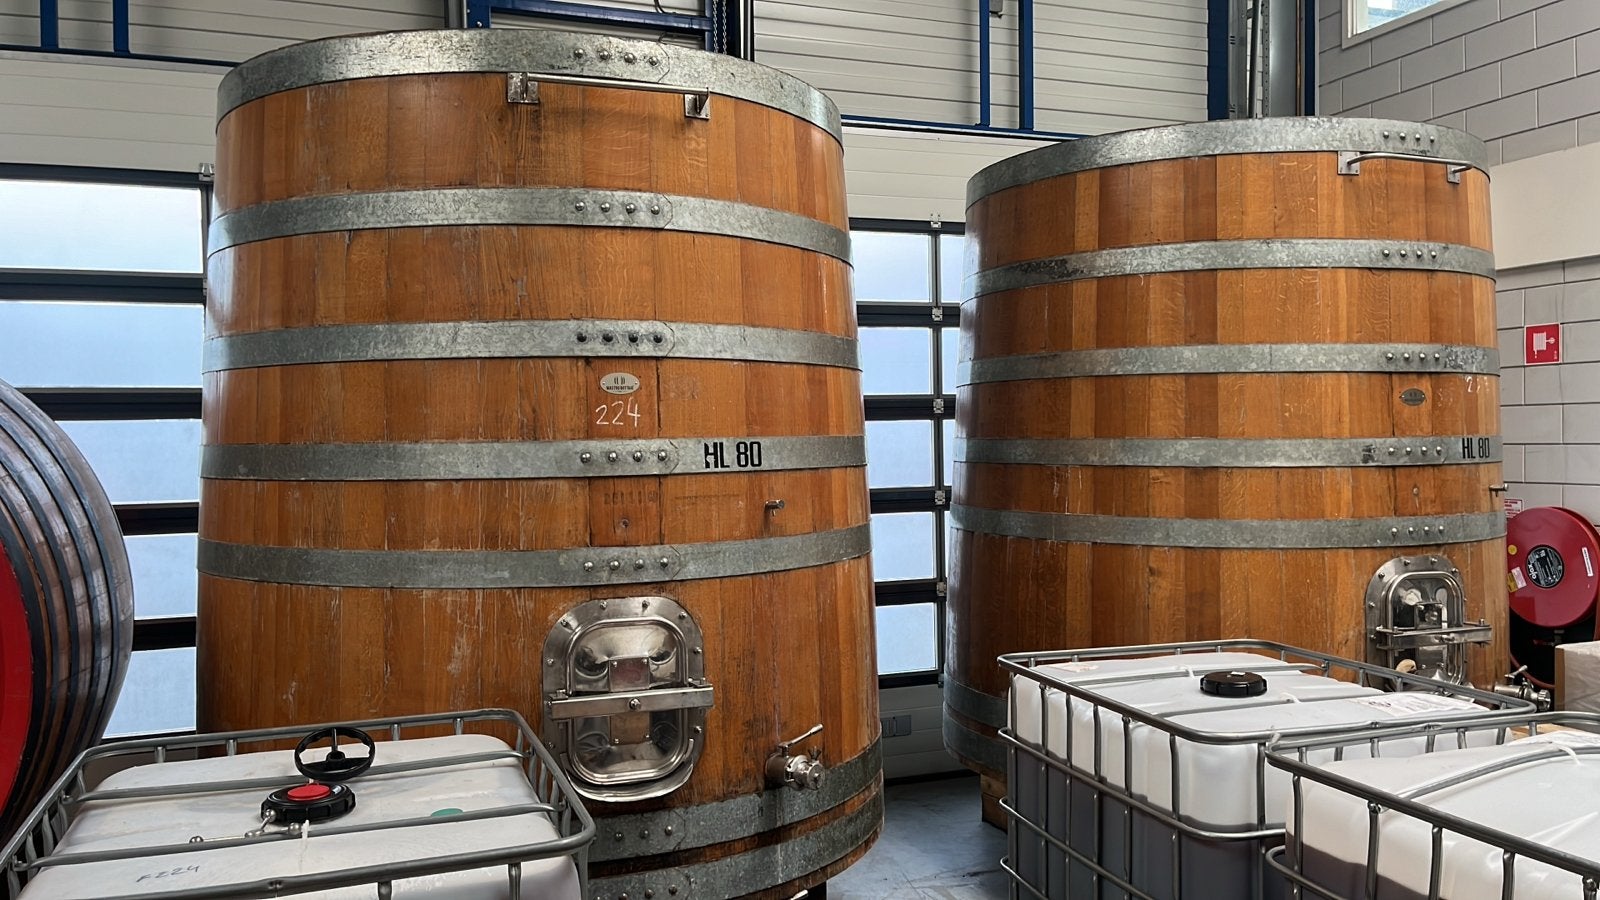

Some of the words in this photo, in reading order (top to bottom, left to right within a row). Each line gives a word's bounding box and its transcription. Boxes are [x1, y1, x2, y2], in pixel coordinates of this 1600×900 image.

[595, 396, 641, 428] 224
[704, 441, 730, 469] HL
[736, 441, 762, 468] 80
[1462, 437, 1476, 459] HL
[1478, 437, 1490, 459] 80
